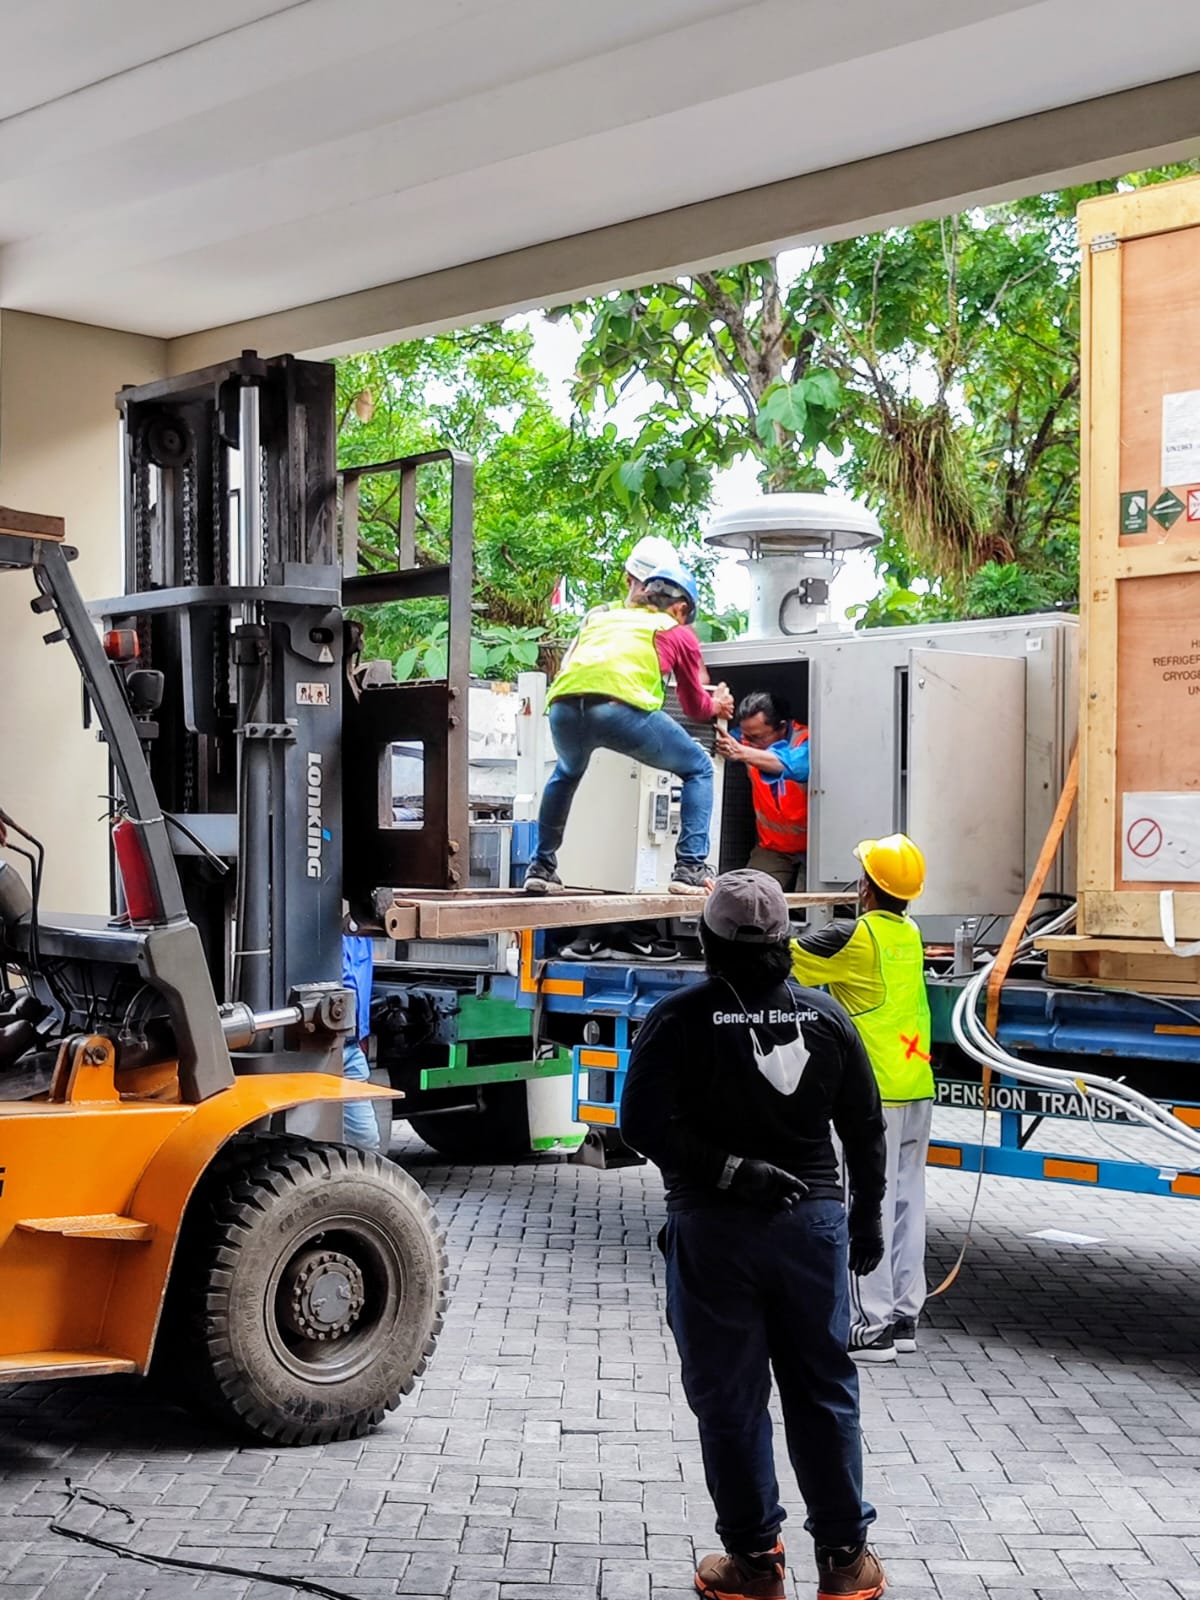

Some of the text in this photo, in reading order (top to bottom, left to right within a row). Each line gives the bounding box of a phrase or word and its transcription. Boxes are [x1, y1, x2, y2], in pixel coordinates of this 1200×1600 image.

[712, 1008, 819, 1025] General Electric
[935, 1082, 1026, 1111] PENSION
